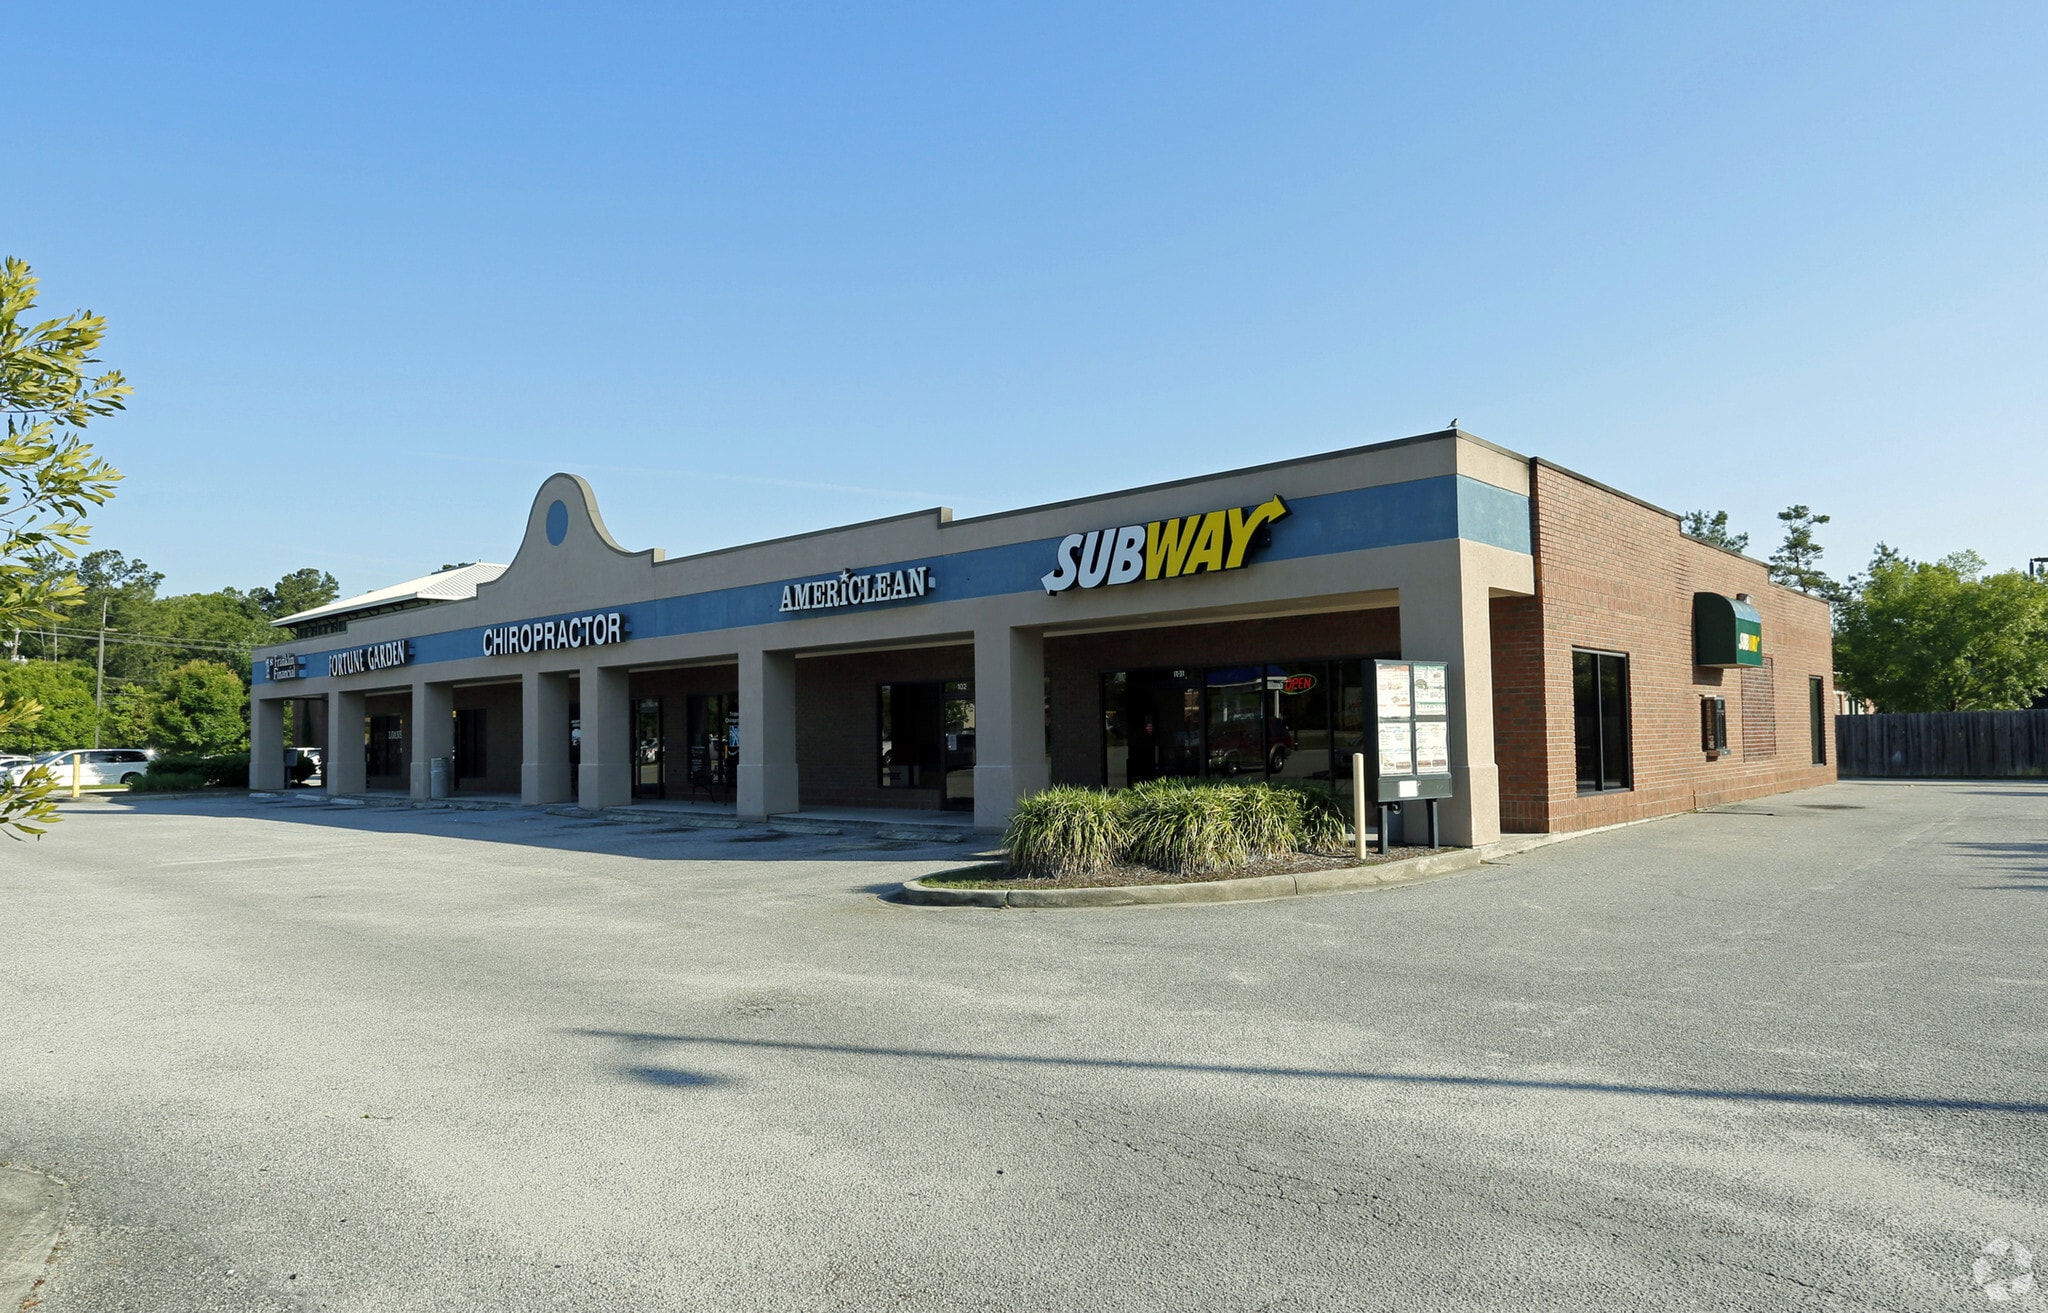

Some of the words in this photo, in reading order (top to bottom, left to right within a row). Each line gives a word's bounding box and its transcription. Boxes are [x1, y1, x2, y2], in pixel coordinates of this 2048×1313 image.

[1041, 494, 1287, 595] SUBWAY
[482, 612, 621, 656] CHIROPRACTOR
[328, 649, 365, 677] FORTUNE
[367, 639, 405, 670] GARDEN
[1284, 677, 1312, 690] OPEN
